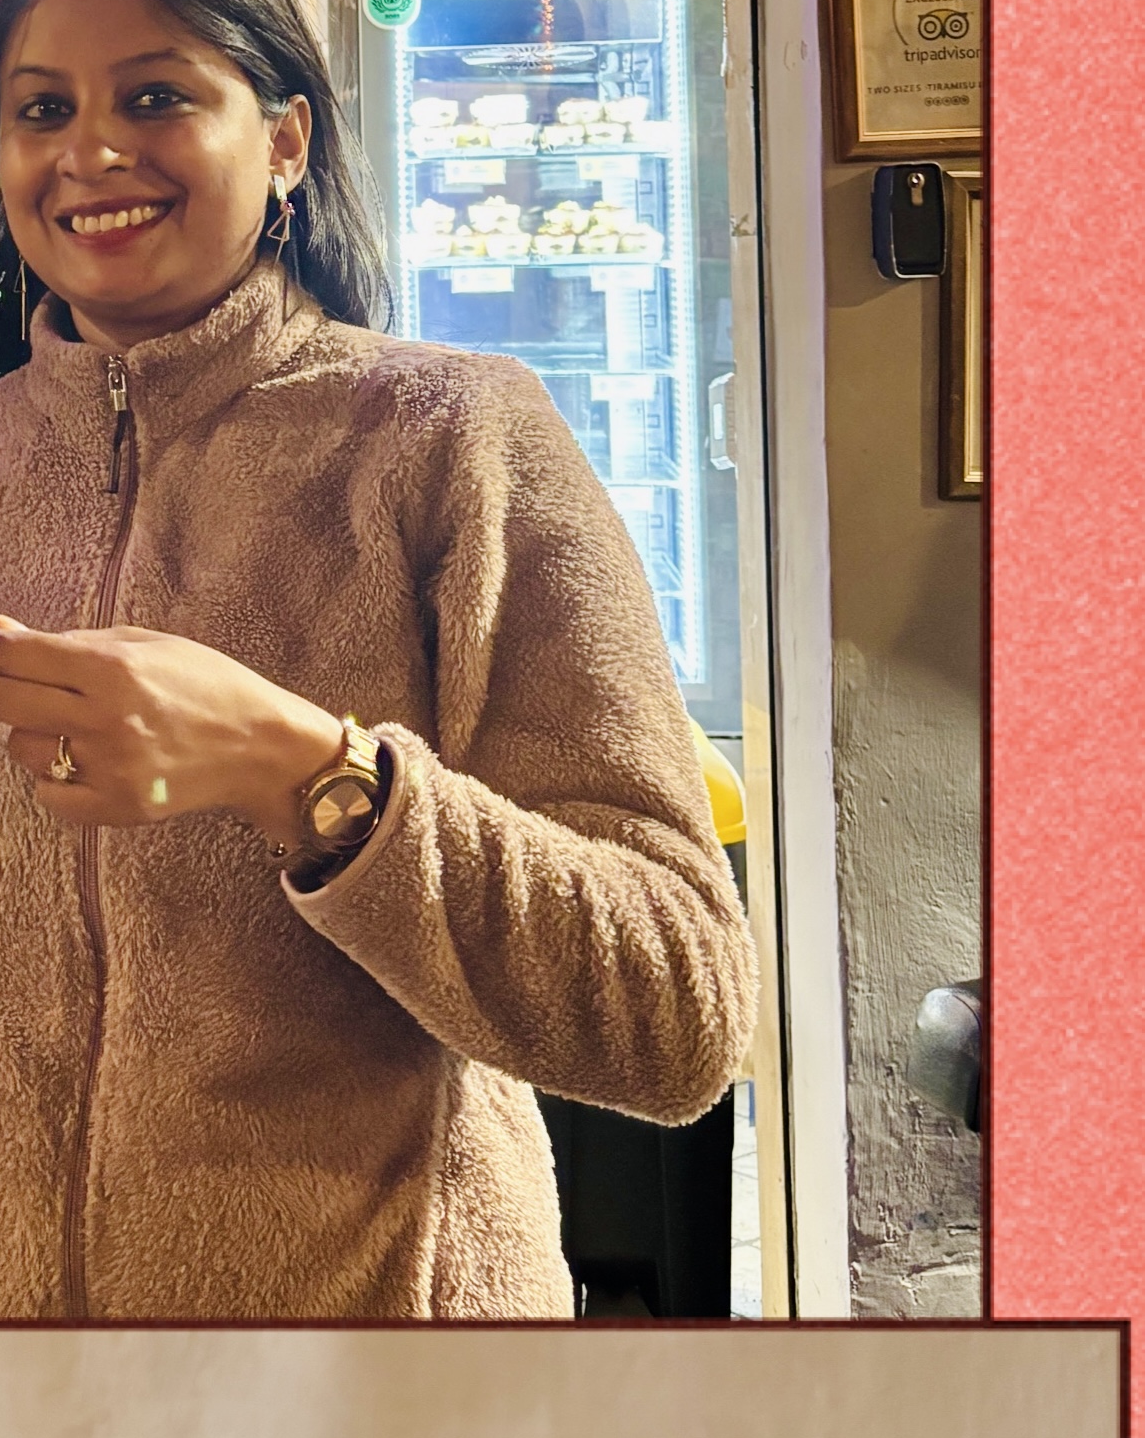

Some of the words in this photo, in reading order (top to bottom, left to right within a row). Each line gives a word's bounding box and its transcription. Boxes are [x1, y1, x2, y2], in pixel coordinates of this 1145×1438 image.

[904, 45, 981, 65] tripadvisor
[867, 86, 891, 94] TWO
[893, 84, 922, 94] SIZES
